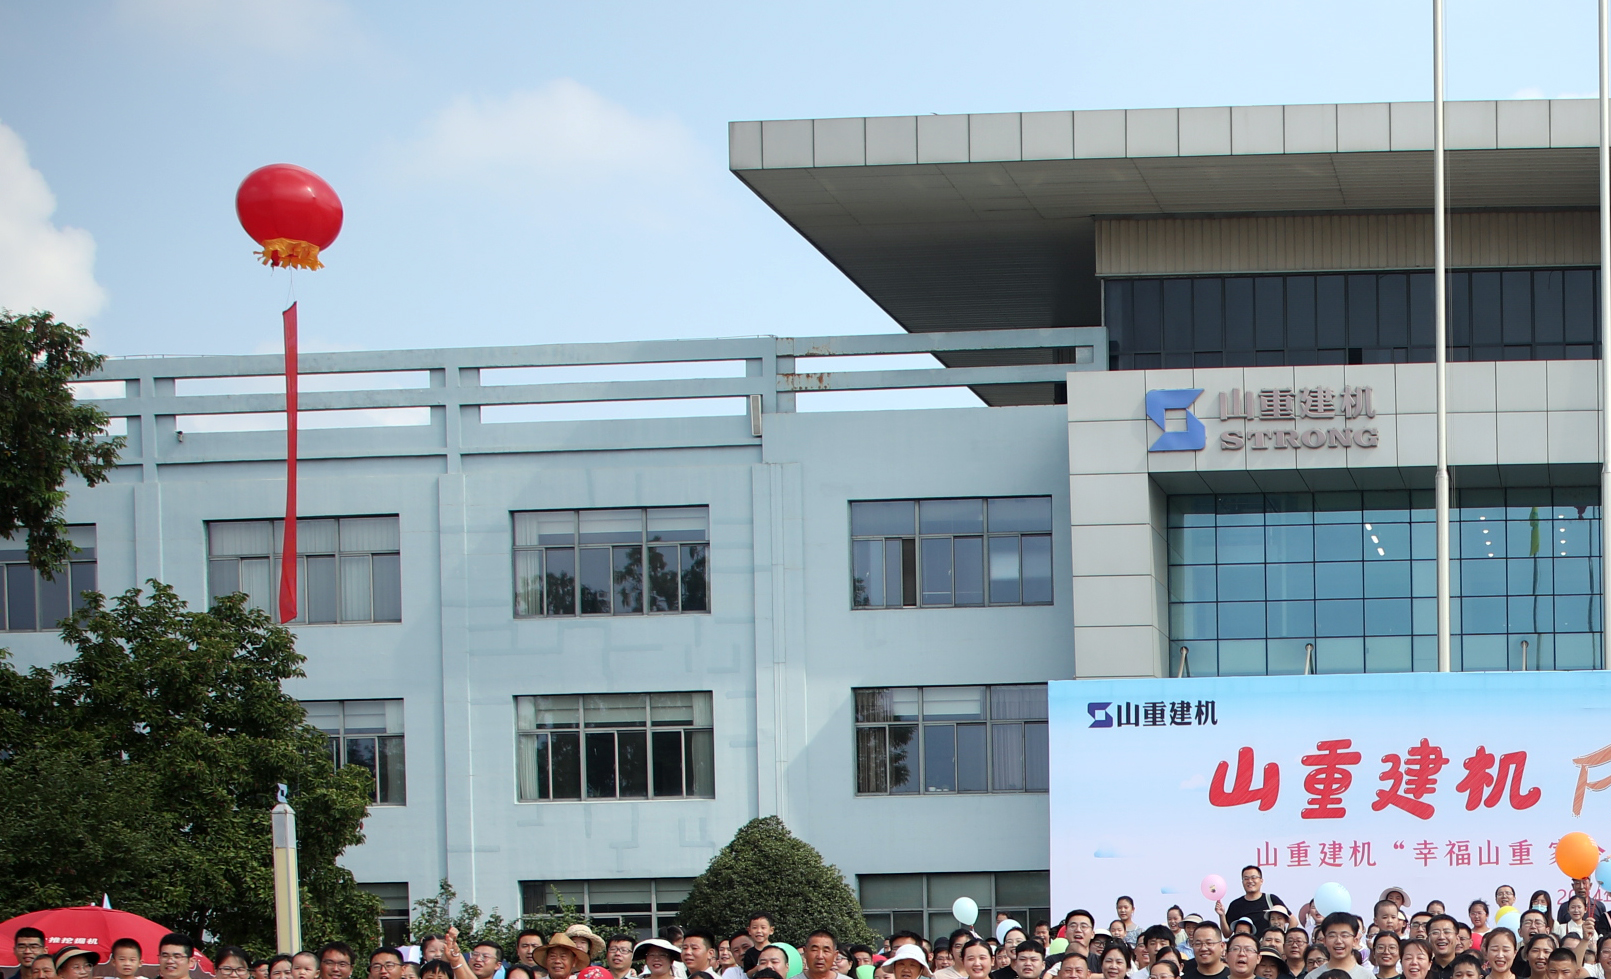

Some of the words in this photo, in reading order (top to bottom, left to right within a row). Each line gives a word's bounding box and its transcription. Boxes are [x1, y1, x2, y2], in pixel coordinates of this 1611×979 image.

[1218, 385, 1376, 421] 山重建机
[1220, 428, 1379, 450] STRONG
[1117, 700, 1218, 727] 山重建机
[1208, 737, 1541, 820] 山重建机
